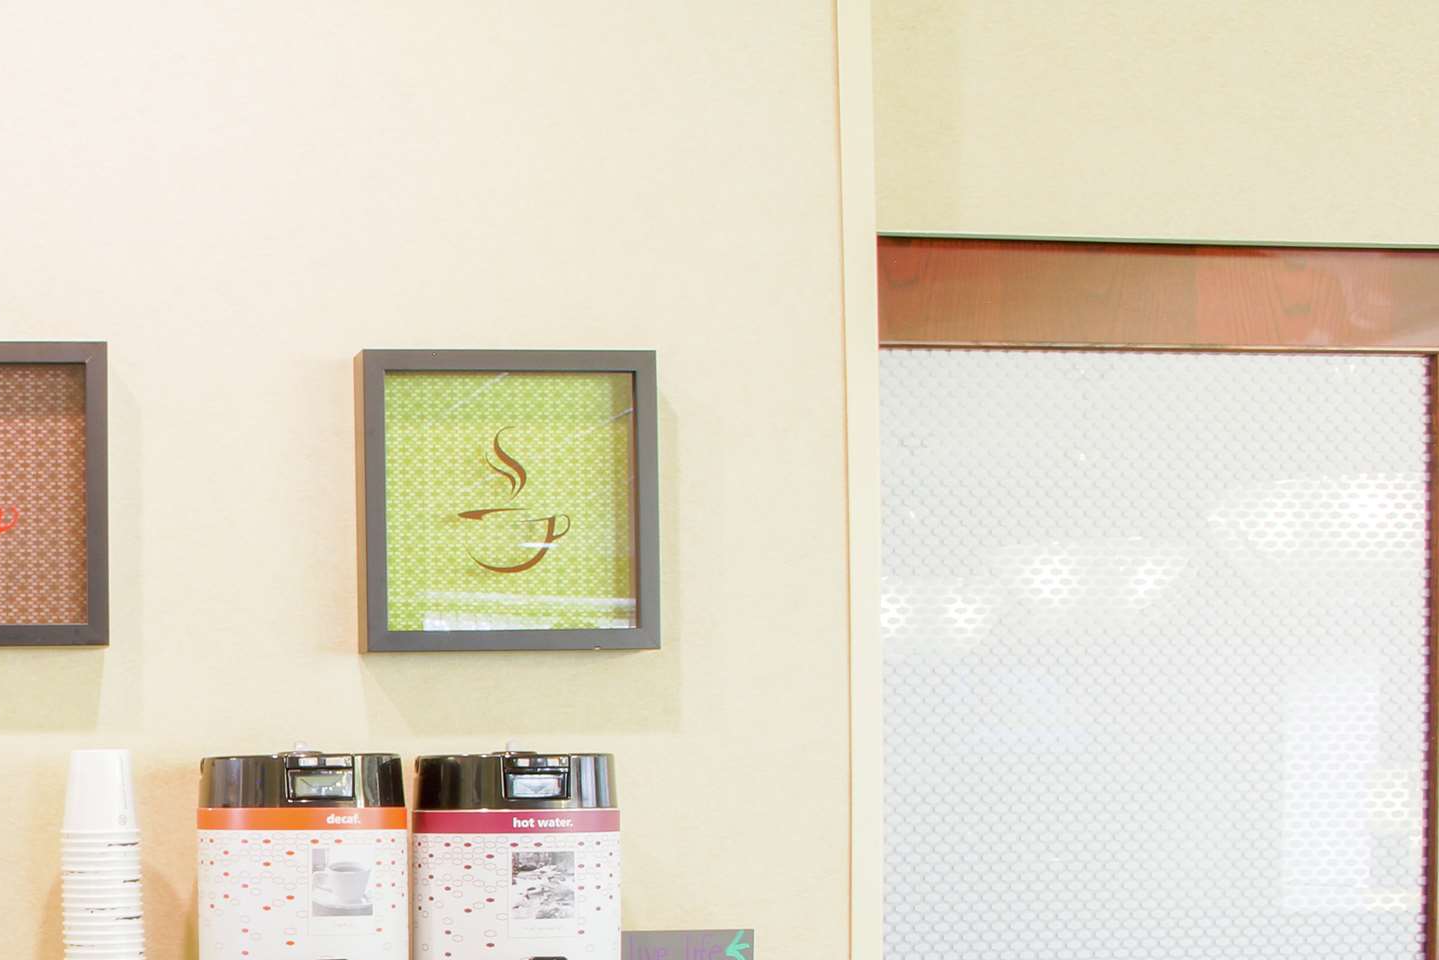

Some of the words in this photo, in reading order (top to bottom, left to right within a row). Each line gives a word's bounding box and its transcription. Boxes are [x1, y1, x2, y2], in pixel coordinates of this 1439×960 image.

[326, 813, 361, 825] decaf.
[513, 816, 535, 828] hot
[538, 817, 574, 828] water.
